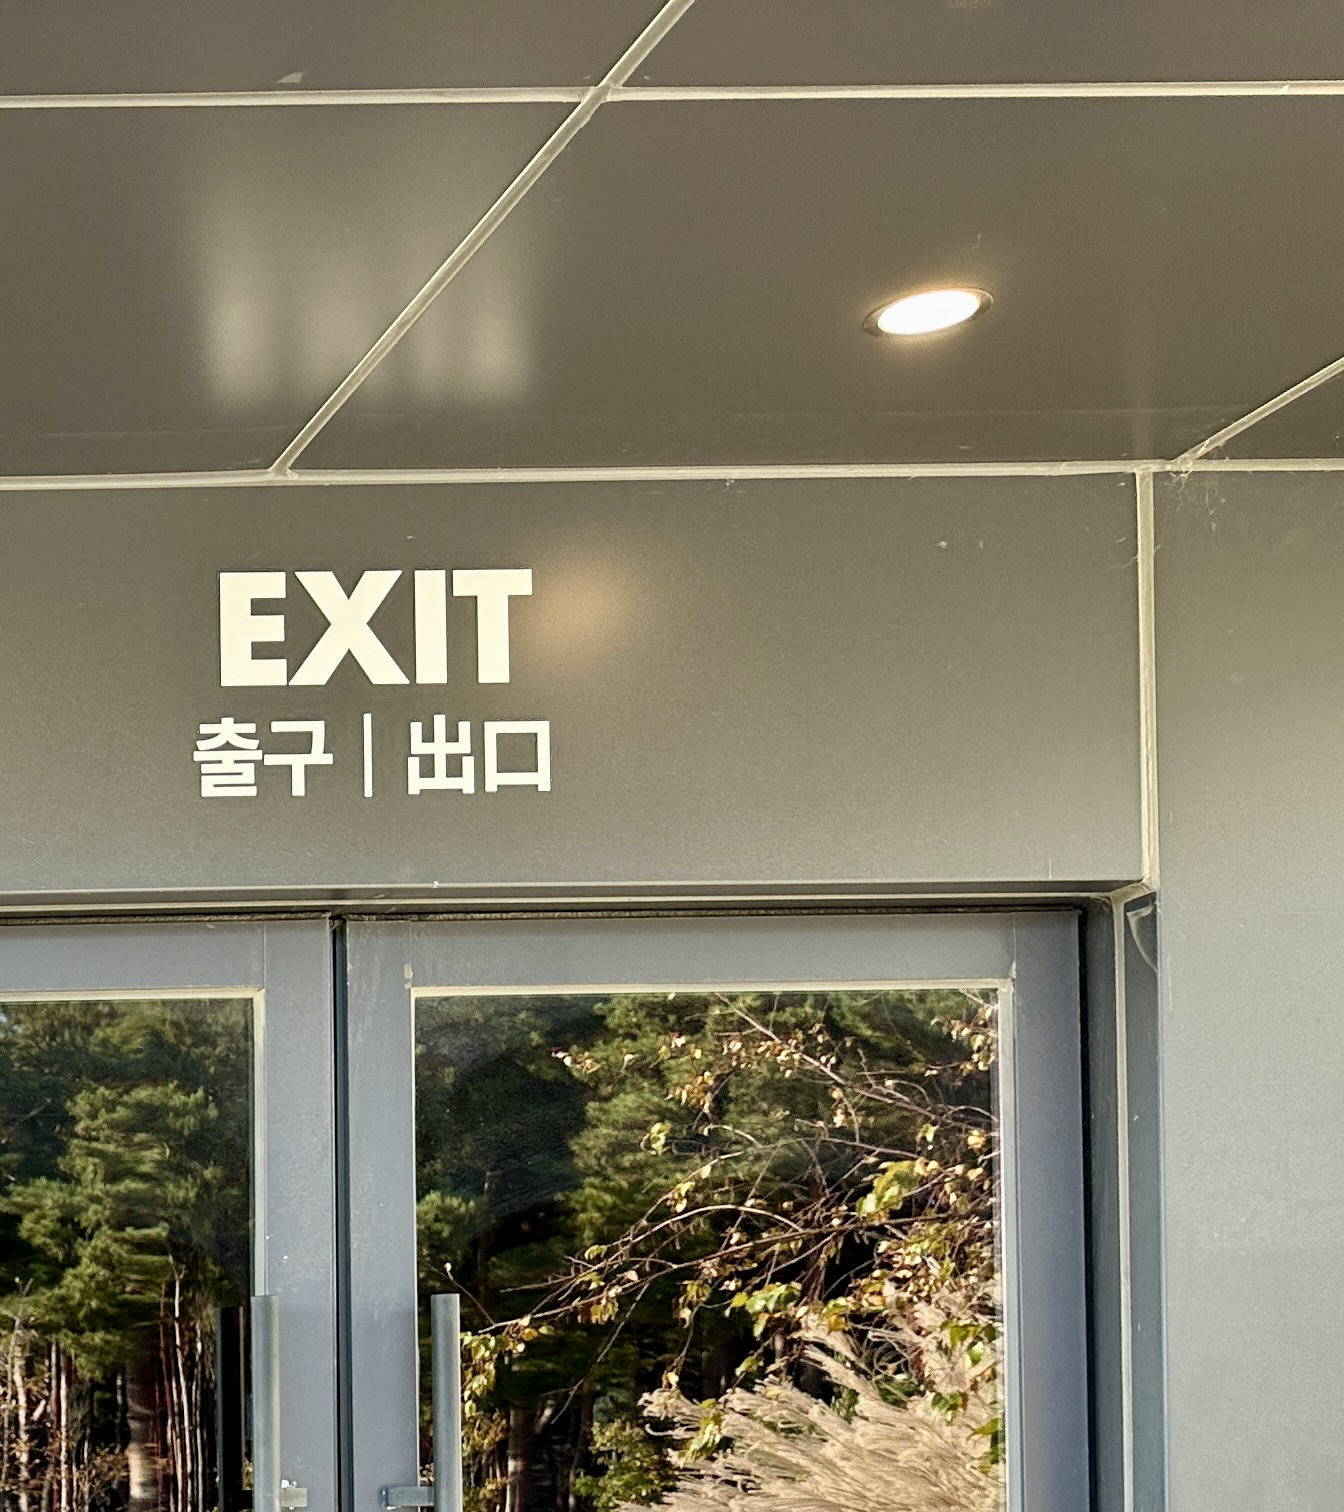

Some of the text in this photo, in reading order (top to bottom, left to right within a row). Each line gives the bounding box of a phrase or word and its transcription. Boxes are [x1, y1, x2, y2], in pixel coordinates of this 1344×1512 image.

[219, 568, 533, 687] EXIT
[193, 714, 551, 798] 출구 出口
